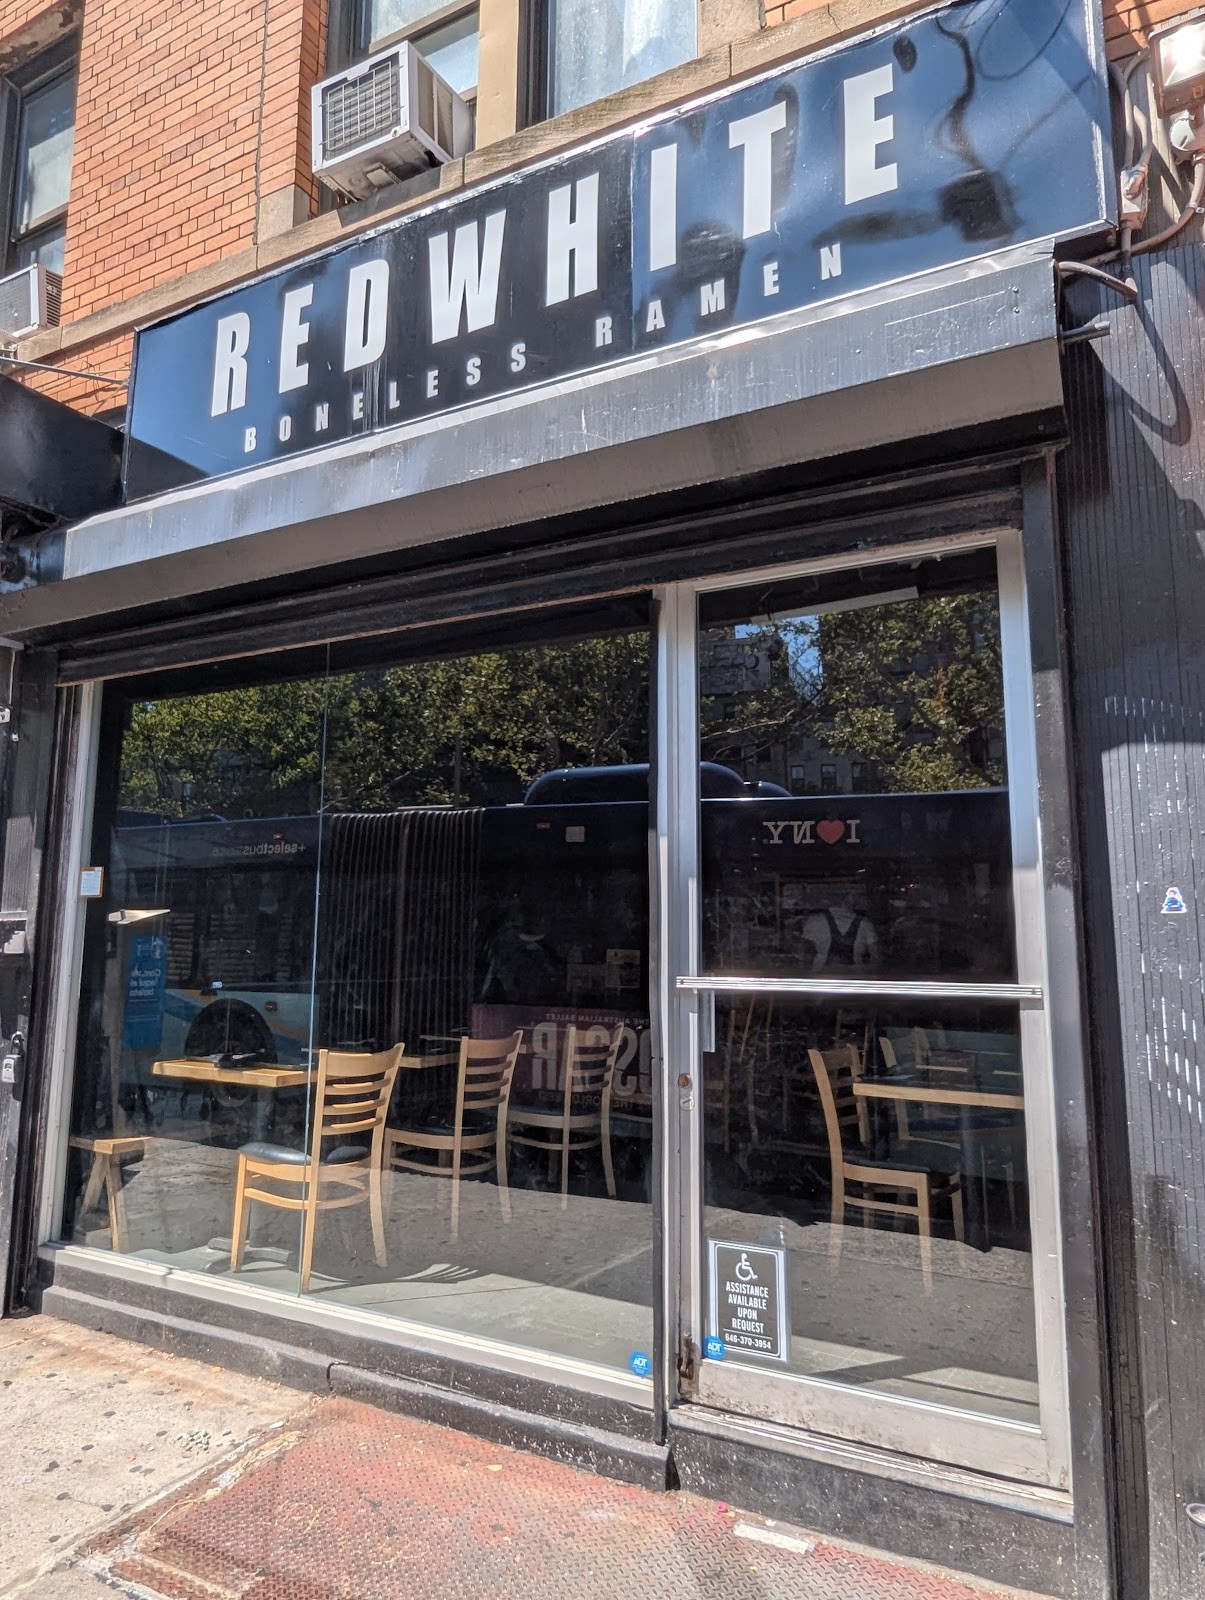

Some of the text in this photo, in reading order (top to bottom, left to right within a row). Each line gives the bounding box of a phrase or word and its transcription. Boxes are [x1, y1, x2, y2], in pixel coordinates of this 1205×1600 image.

[210, 62, 900, 418] REDWHITE
[242, 242, 843, 454] BONELESS RAMEN
[725, 1281, 769, 1298] ASSISTANCE
[728, 1293, 768, 1310] AVAILABLE
[737, 1307, 758, 1320] UPON
[731, 1318, 765, 1334] REQUEST
[707, 1342, 723, 1352] ADT
[725, 1333, 772, 1350] 646-370-3954
[633, 1357, 648, 1367] ADT
